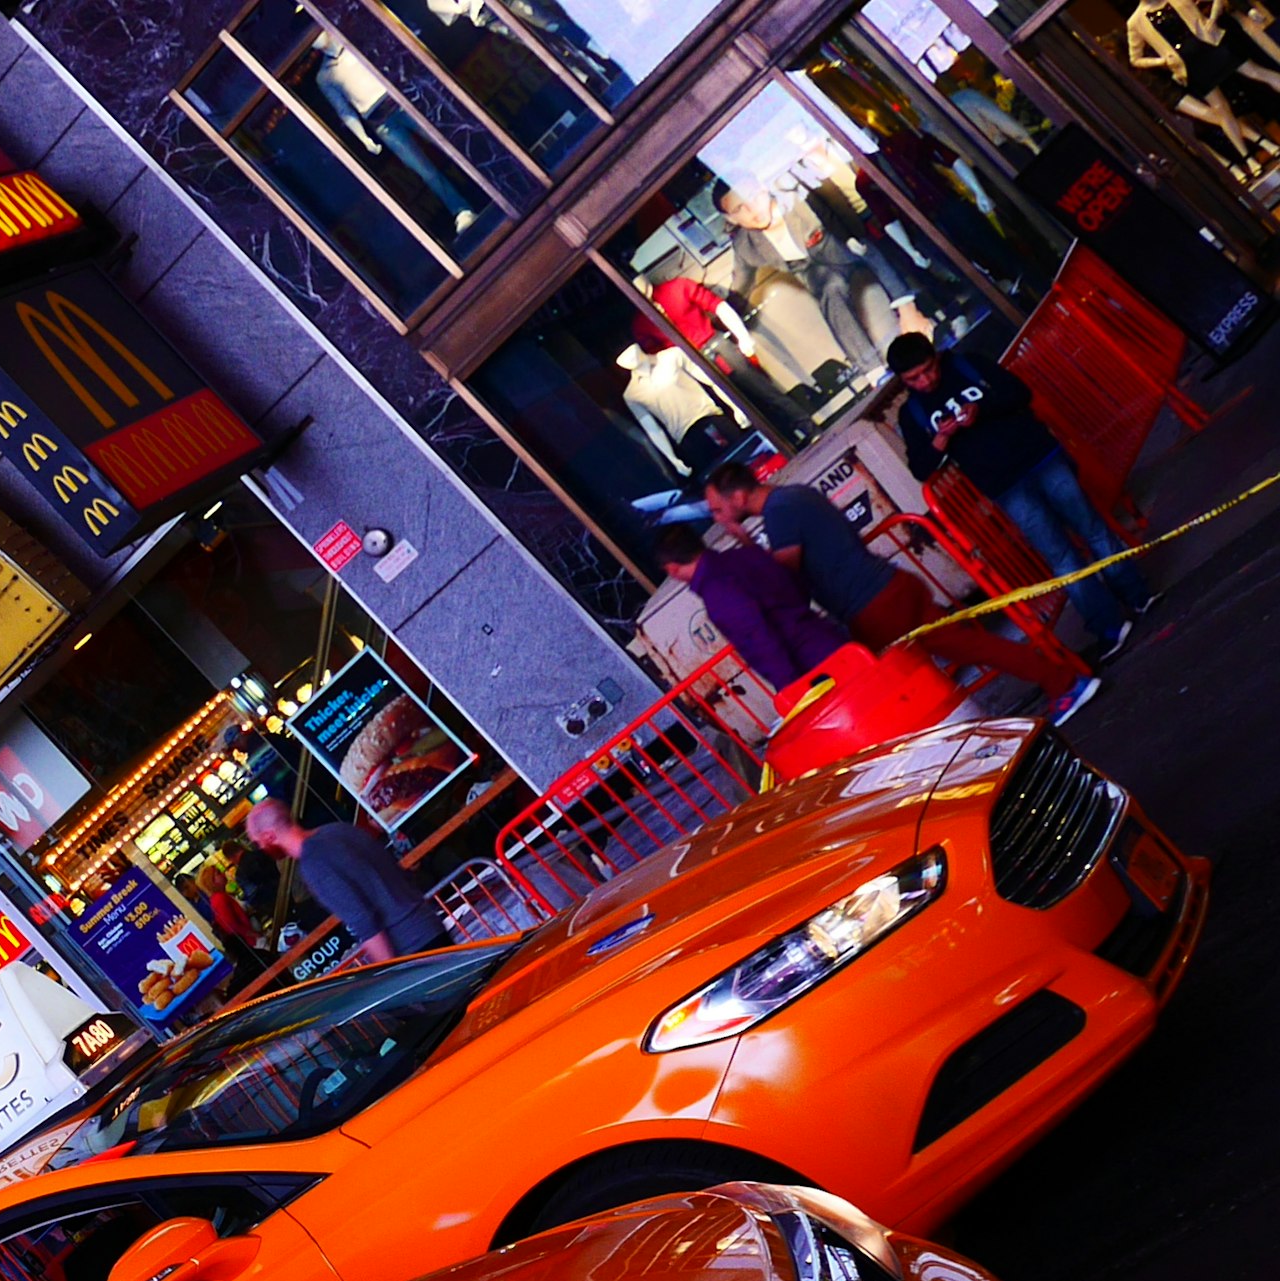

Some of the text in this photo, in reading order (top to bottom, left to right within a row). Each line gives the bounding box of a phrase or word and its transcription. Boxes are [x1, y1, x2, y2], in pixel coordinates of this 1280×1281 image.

[1056, 159, 1114, 214] WE'RE
[1076, 175, 1133, 231] OPEN!
[1208, 291, 1258, 345] EXPRESS
[845, 501, 866, 522] 85
[303, 690, 355, 732] Thicker,
[317, 712, 350, 743] meet
[76, 808, 131, 861] TIMES
[141, 733, 211, 801] SQUARE
[78, 900, 114, 934] Summer
[110, 879, 139, 906] Break
[102, 900, 127, 926] Menu
[293, 936, 340, 981] GROUP
[71, 1019, 114, 1057] 7A80
